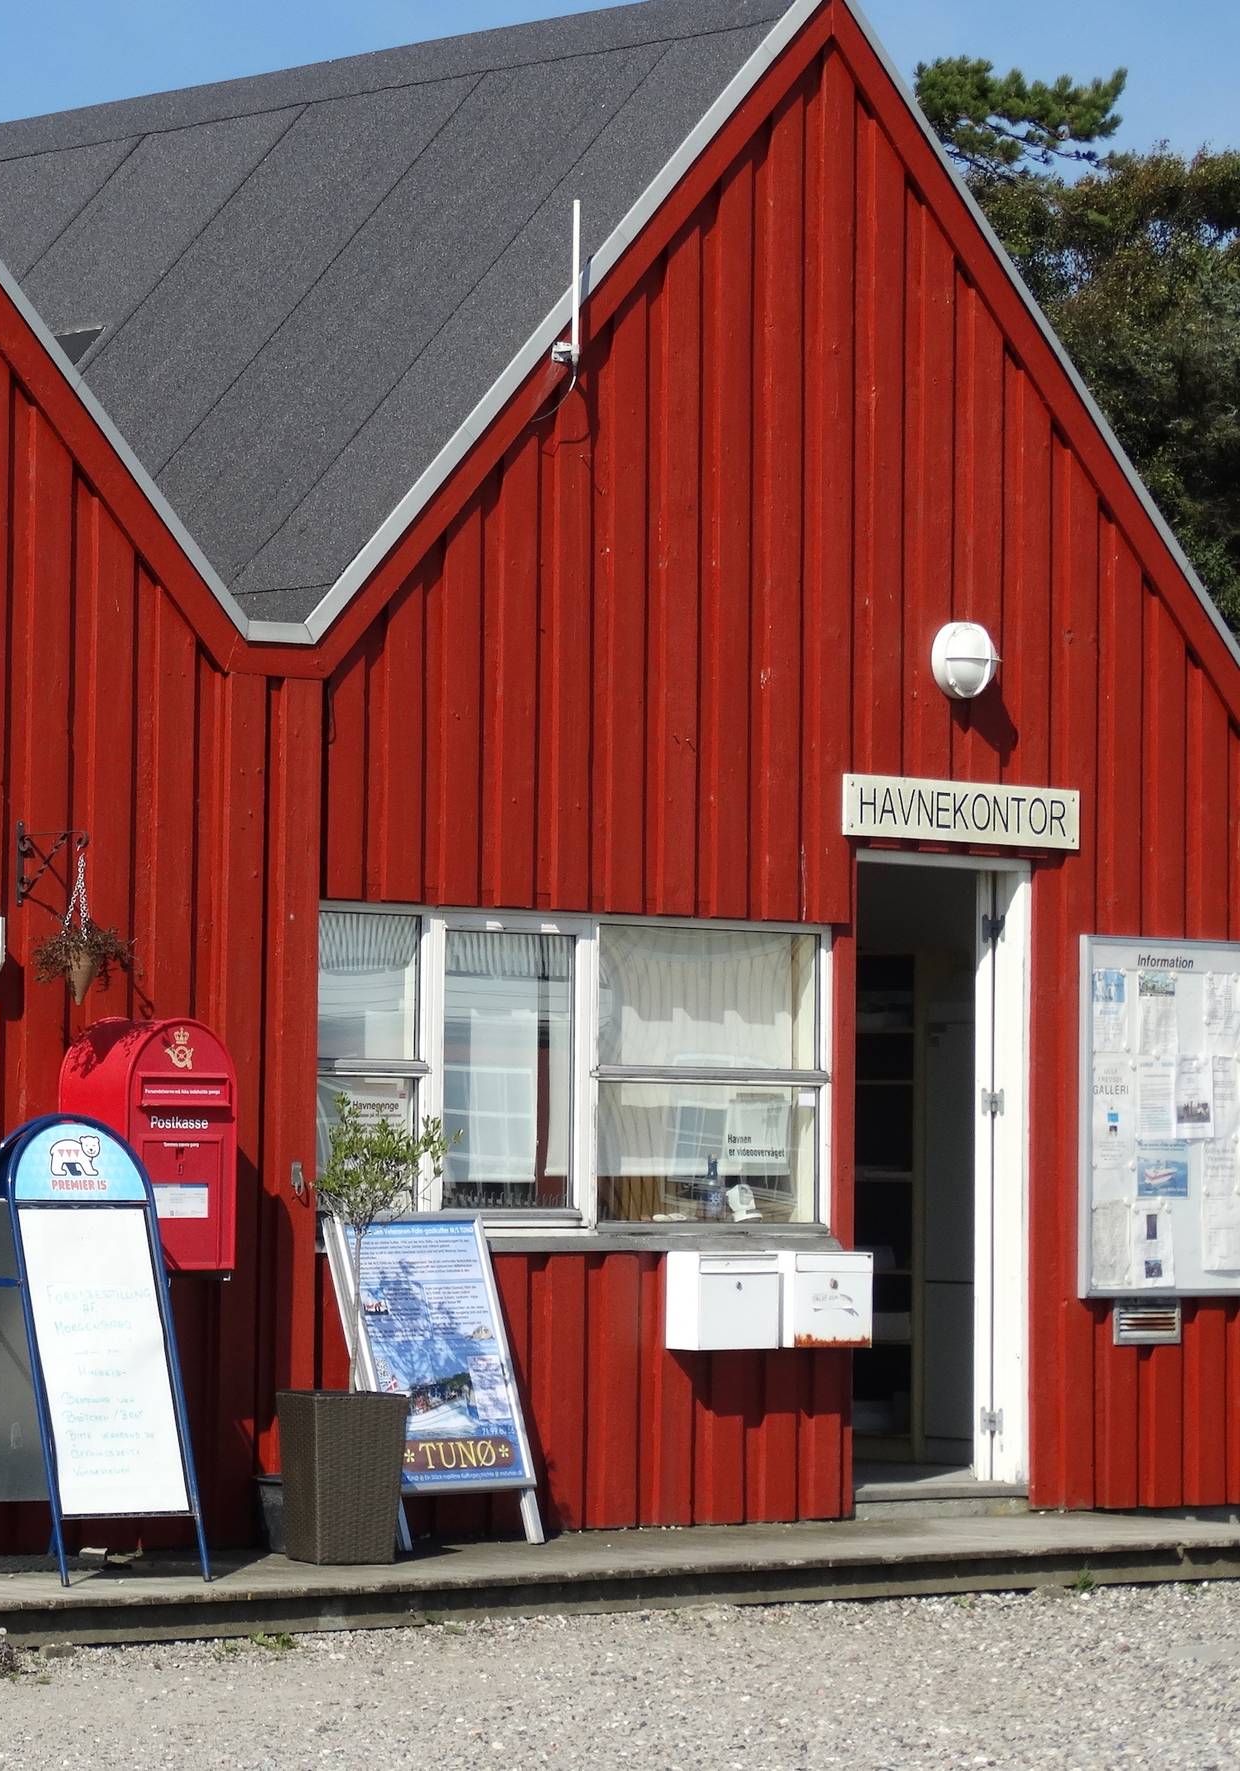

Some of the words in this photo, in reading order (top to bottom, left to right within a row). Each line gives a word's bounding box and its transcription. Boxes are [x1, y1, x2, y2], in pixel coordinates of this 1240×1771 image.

[859, 786, 1067, 837] HAVNEKONTOR
[1137, 953, 1194, 969] Information
[1092, 1084, 1129, 1096] GALLERI
[150, 1115, 209, 1130] Postkasse
[727, 1133, 752, 1144] Havnen
[728, 1148, 736, 1157] er
[736, 1147, 785, 1160] videoovervåget
[51, 1179, 95, 1191] PREMIER
[96, 1179, 108, 1190] IS
[418, 1438, 497, 1470] TUNØ
